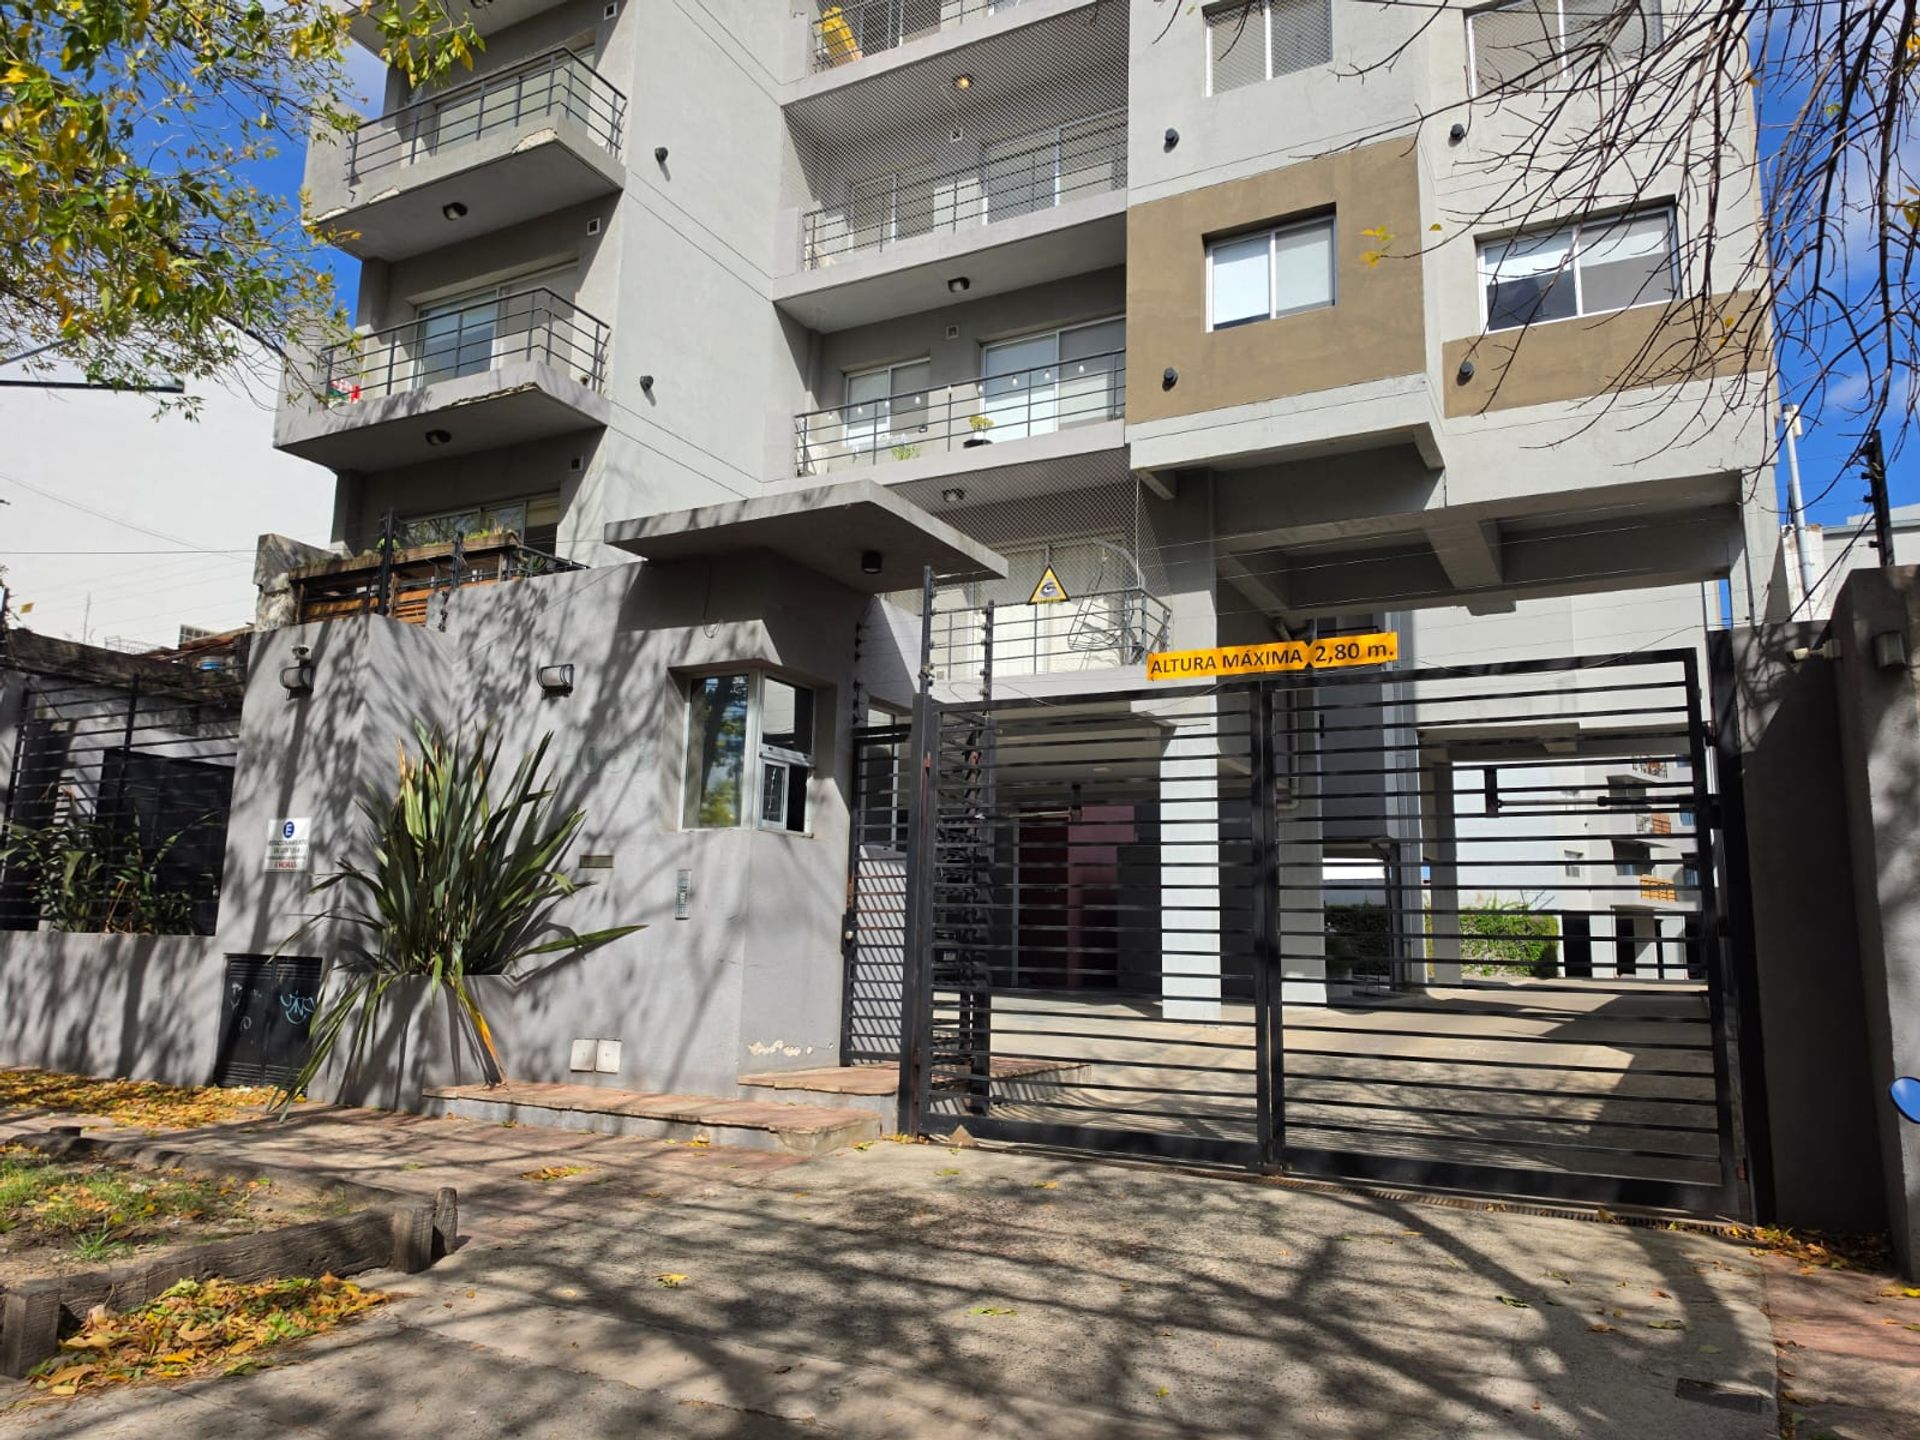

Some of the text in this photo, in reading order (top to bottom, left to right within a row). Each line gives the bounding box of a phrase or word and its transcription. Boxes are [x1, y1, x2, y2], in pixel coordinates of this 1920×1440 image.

[1150, 642, 1394, 675] ALTURA MÁXIMA 2,80 m.
